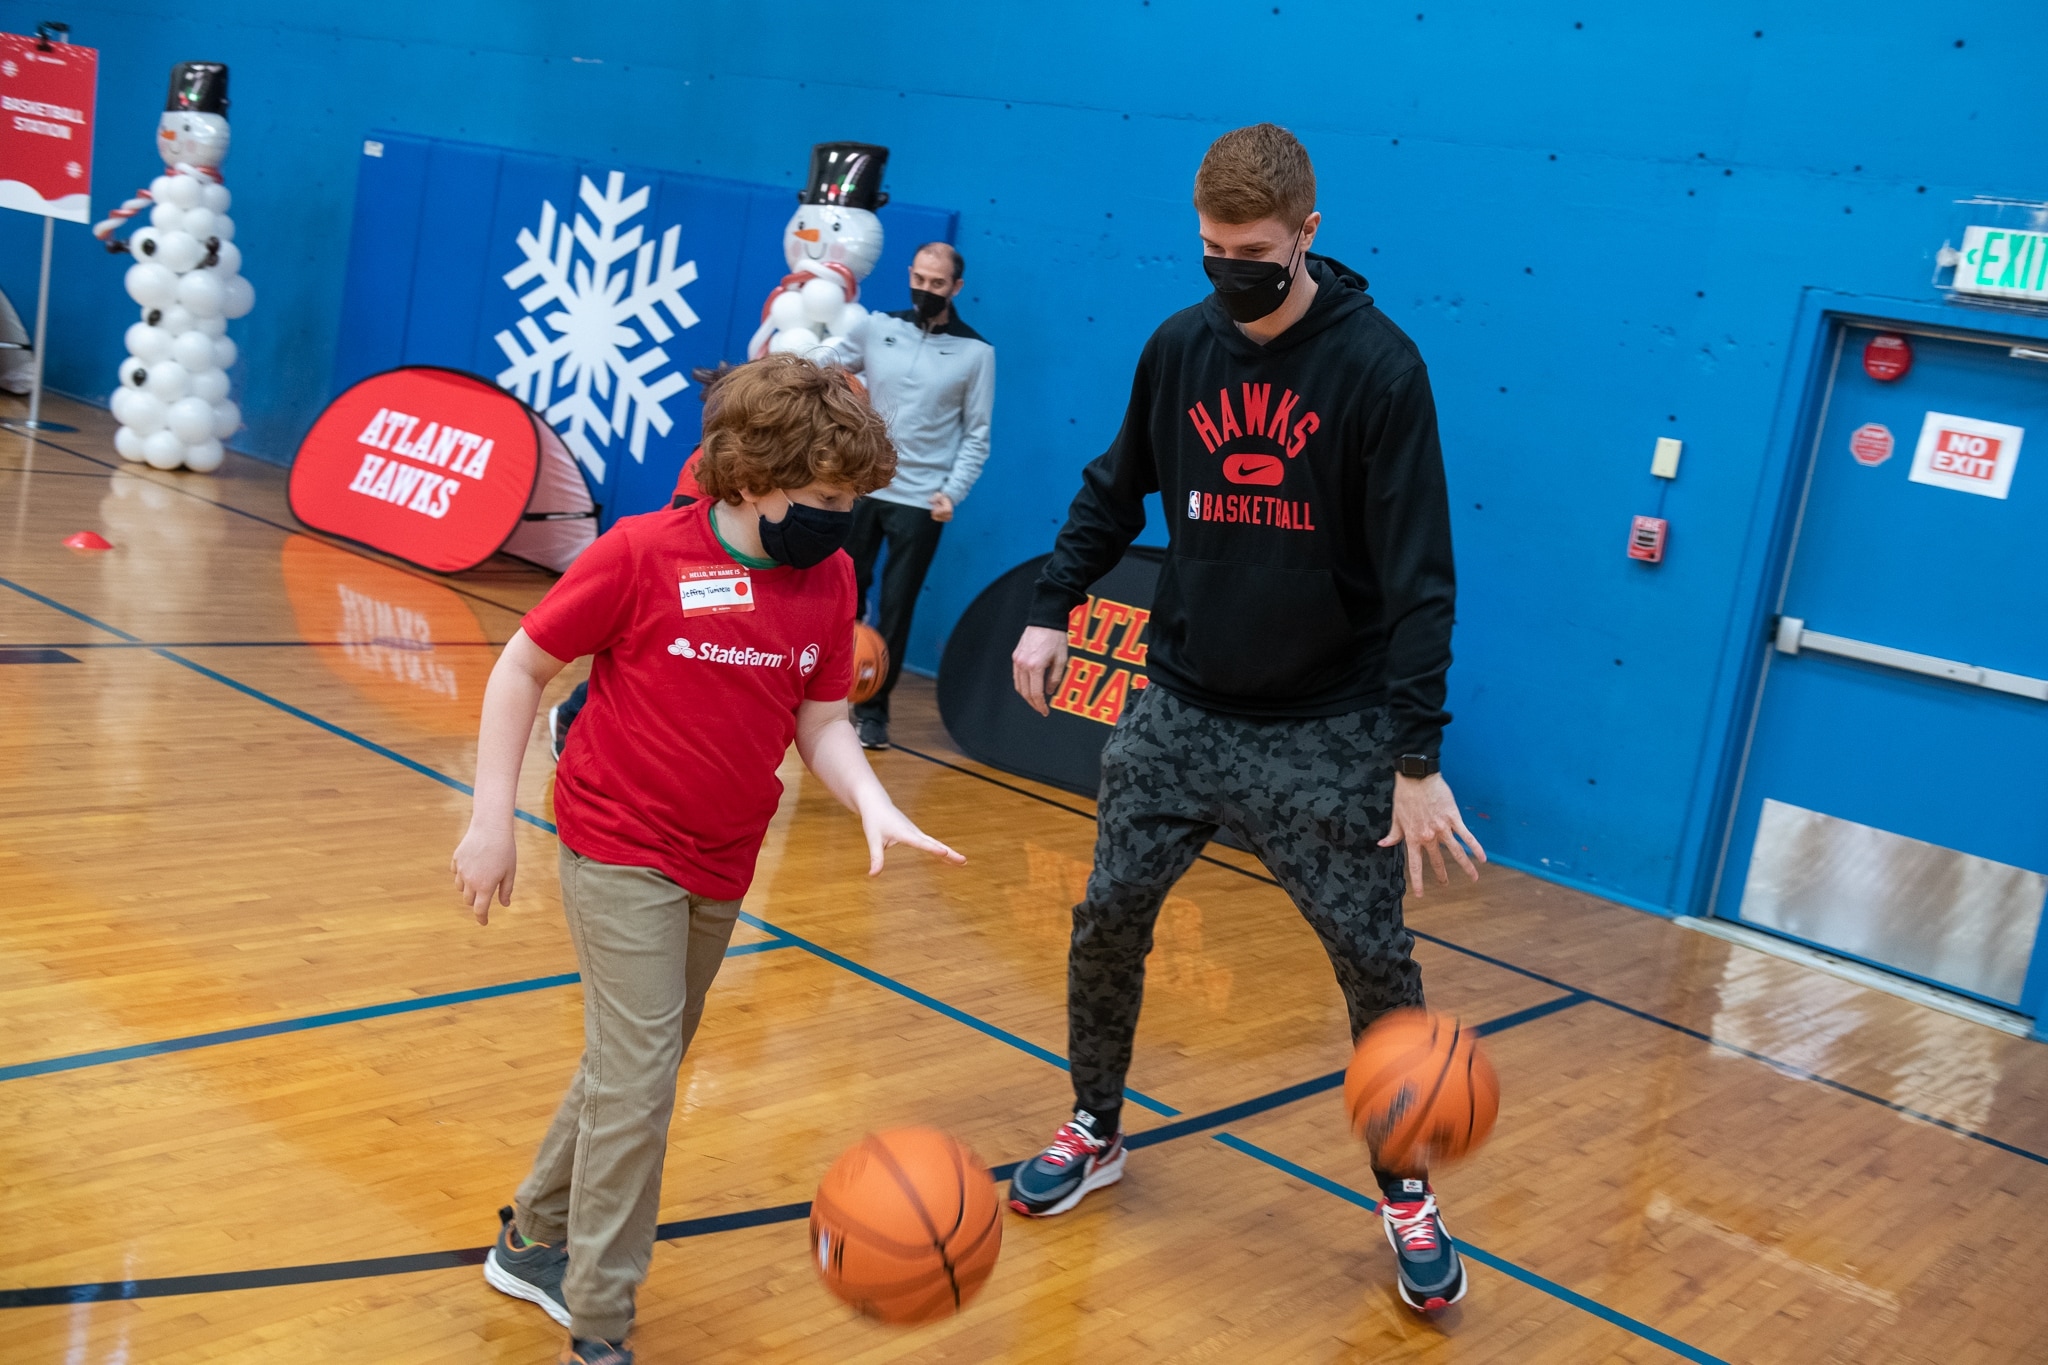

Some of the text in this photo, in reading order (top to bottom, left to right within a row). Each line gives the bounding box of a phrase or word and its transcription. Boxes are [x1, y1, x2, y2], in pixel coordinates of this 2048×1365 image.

[1, 95, 86, 124] BASKETBALL
[13, 116, 72, 140] STATION
[1976, 232, 2048, 291] EXIT
[1187, 382, 1321, 459] HAWKS
[356, 407, 495, 481] ATLANTA
[1947, 433, 1989, 457] NO
[1933, 451, 1995, 478] EXIT
[348, 453, 462, 519] HAWKS
[1202, 492, 1315, 531] BASKETBALL
[717, 569, 734, 577] NAME
[1050, 656, 1149, 726] HA
